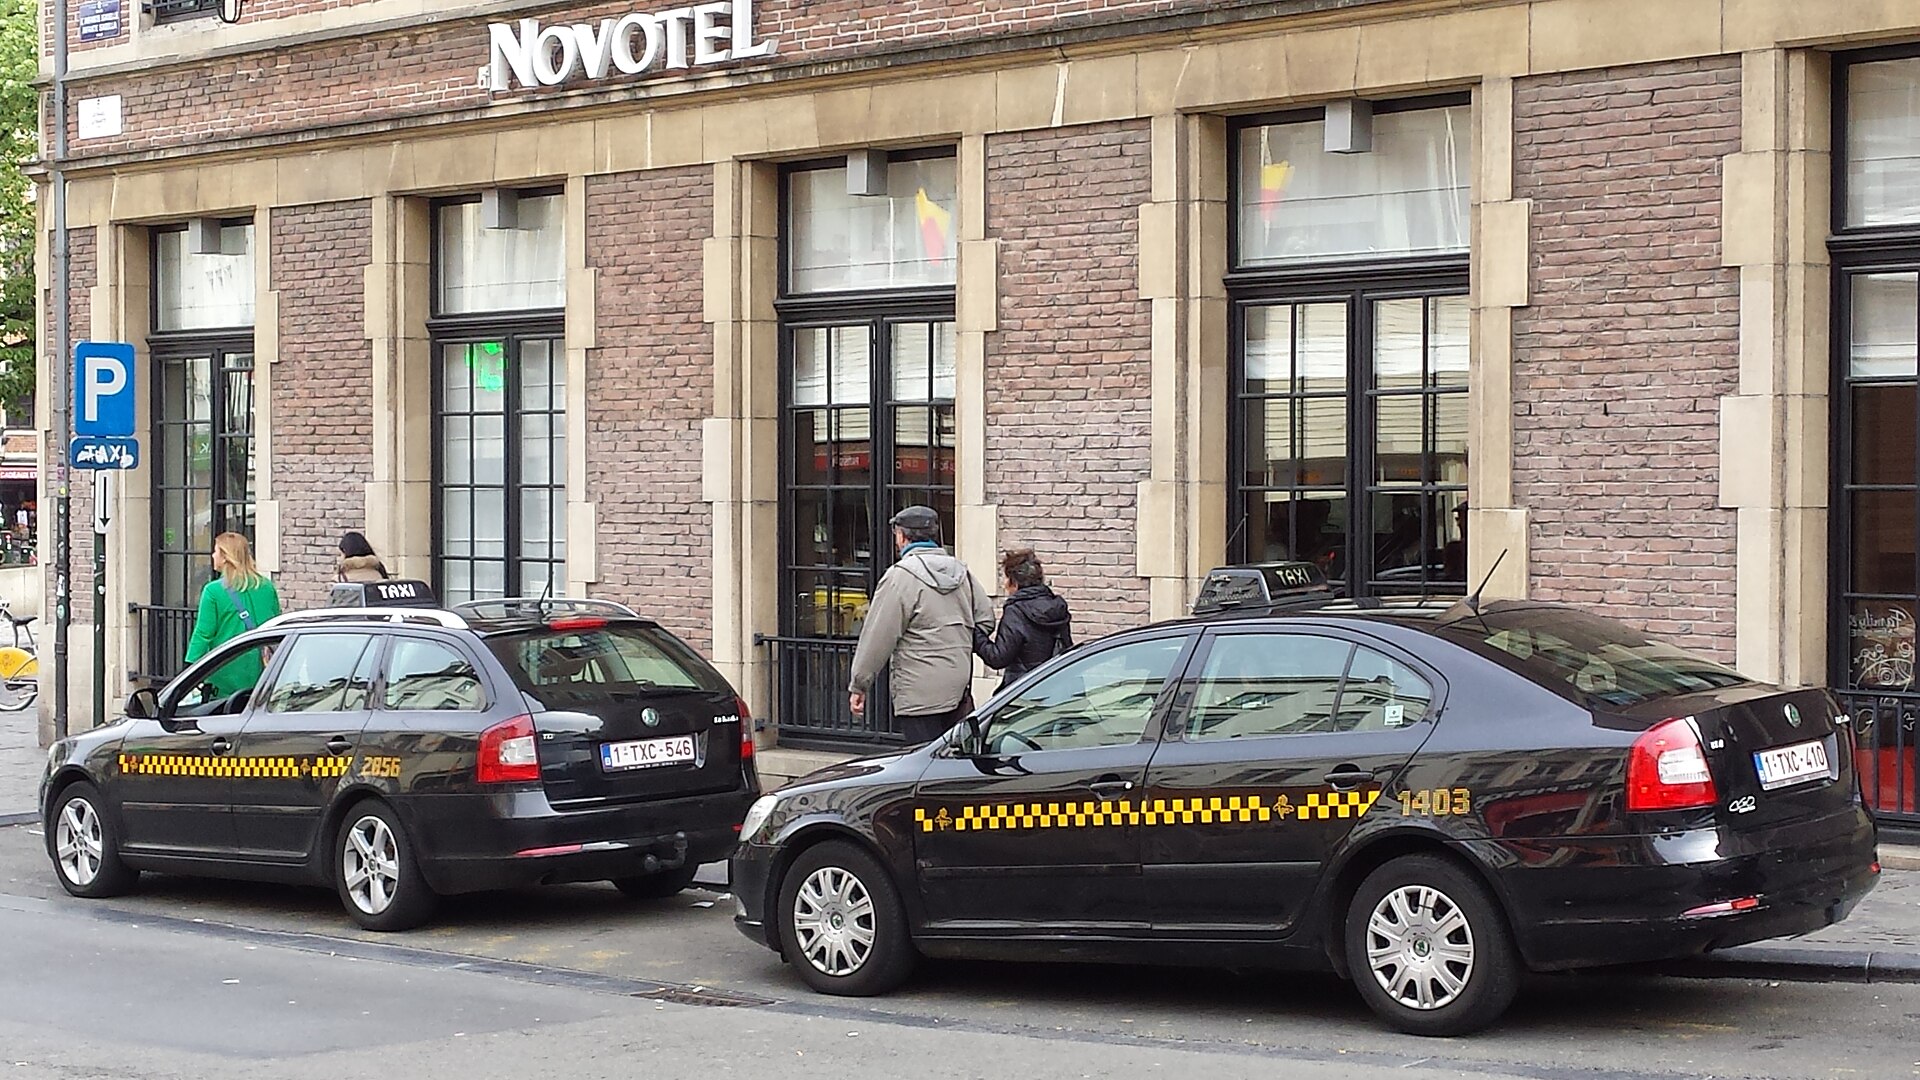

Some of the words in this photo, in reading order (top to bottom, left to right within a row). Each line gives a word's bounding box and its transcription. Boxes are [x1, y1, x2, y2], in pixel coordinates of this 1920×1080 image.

[488, 0, 779, 92] NOVOTEL
[85, 357, 127, 421] P
[84, 445, 127, 463] TAXI
[1275, 567, 1312, 586] TAXI
[377, 583, 416, 599] TAXI
[613, 739, 691, 763] 1-TXC-546
[1765, 745, 1825, 777] 1-TXC-410
[359, 756, 401, 777] 2856
[1398, 788, 1471, 816] 1403
